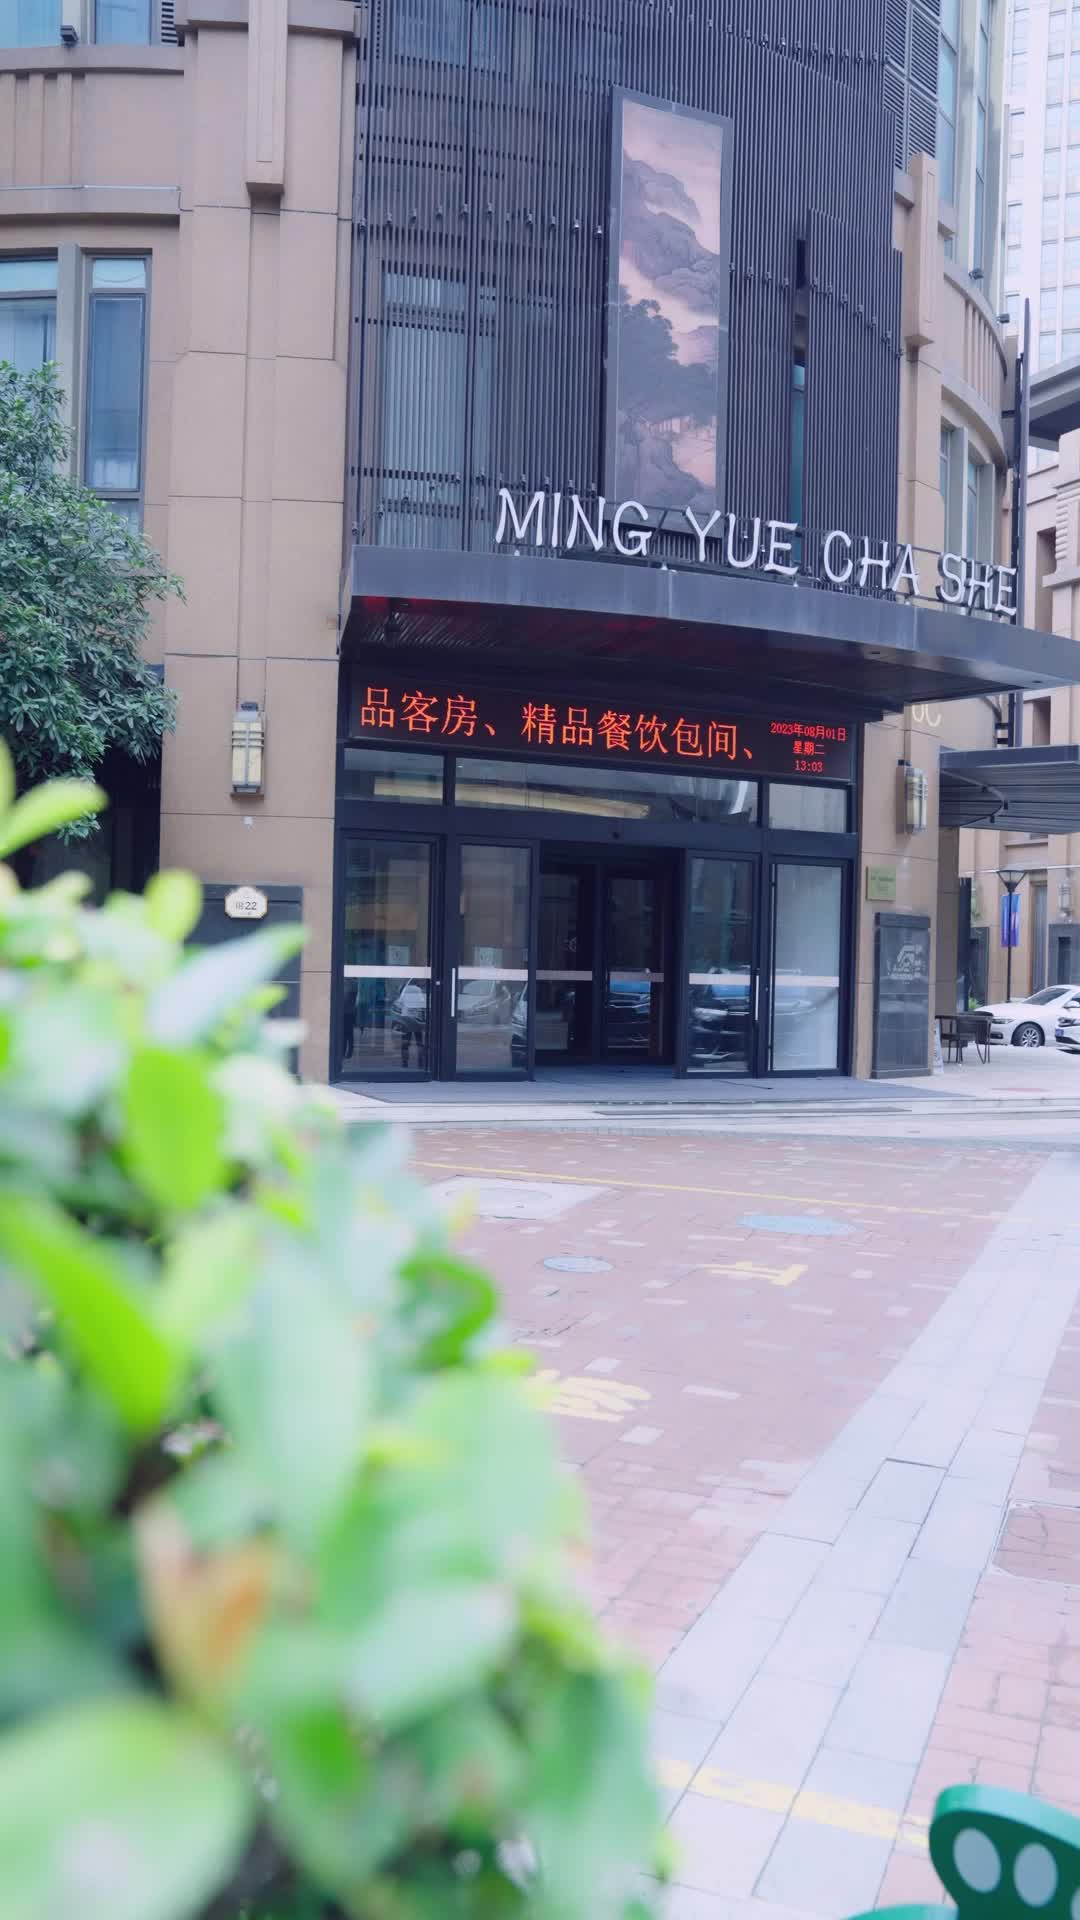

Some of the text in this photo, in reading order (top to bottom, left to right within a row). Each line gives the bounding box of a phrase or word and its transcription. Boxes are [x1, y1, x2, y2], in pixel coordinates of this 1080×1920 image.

[496, 488, 1016, 616] MING YUE CHA SHE
[770, 722, 846, 741] 2023年08月01日
[793, 740, 825, 755] 星期二
[795, 760, 823, 772] 13:03
